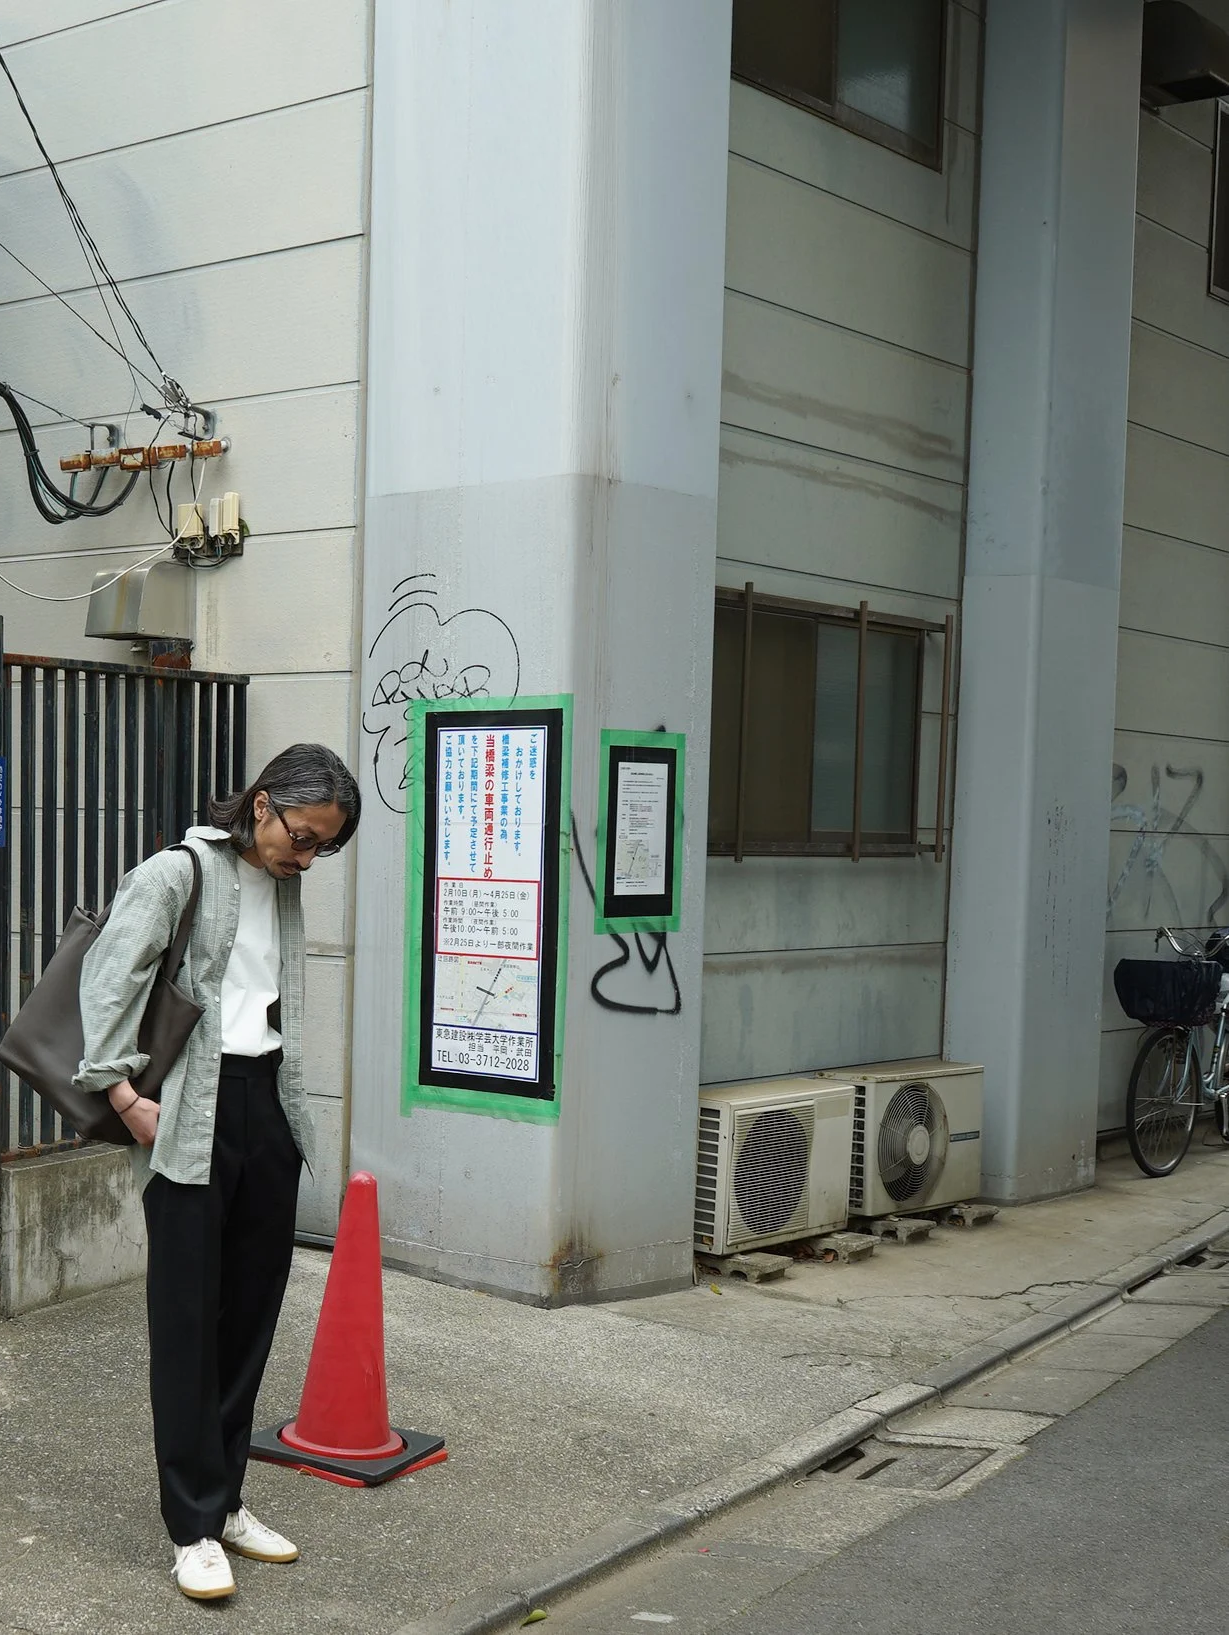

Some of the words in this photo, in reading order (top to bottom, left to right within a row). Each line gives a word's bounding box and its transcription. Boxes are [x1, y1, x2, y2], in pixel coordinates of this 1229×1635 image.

[444, 735, 453, 865] ご協力お願いいたします。
[457, 734, 466, 820] 頂いております。
[470, 735, 479, 873] を下記期間にて予定させて
[483, 733, 495, 879] 当橋梁の車両通行止め
[514, 747, 523, 857] おかけしております。
[529, 733, 538, 780] ご迷惑を
[468, 1042, 485, 1053] 担当
